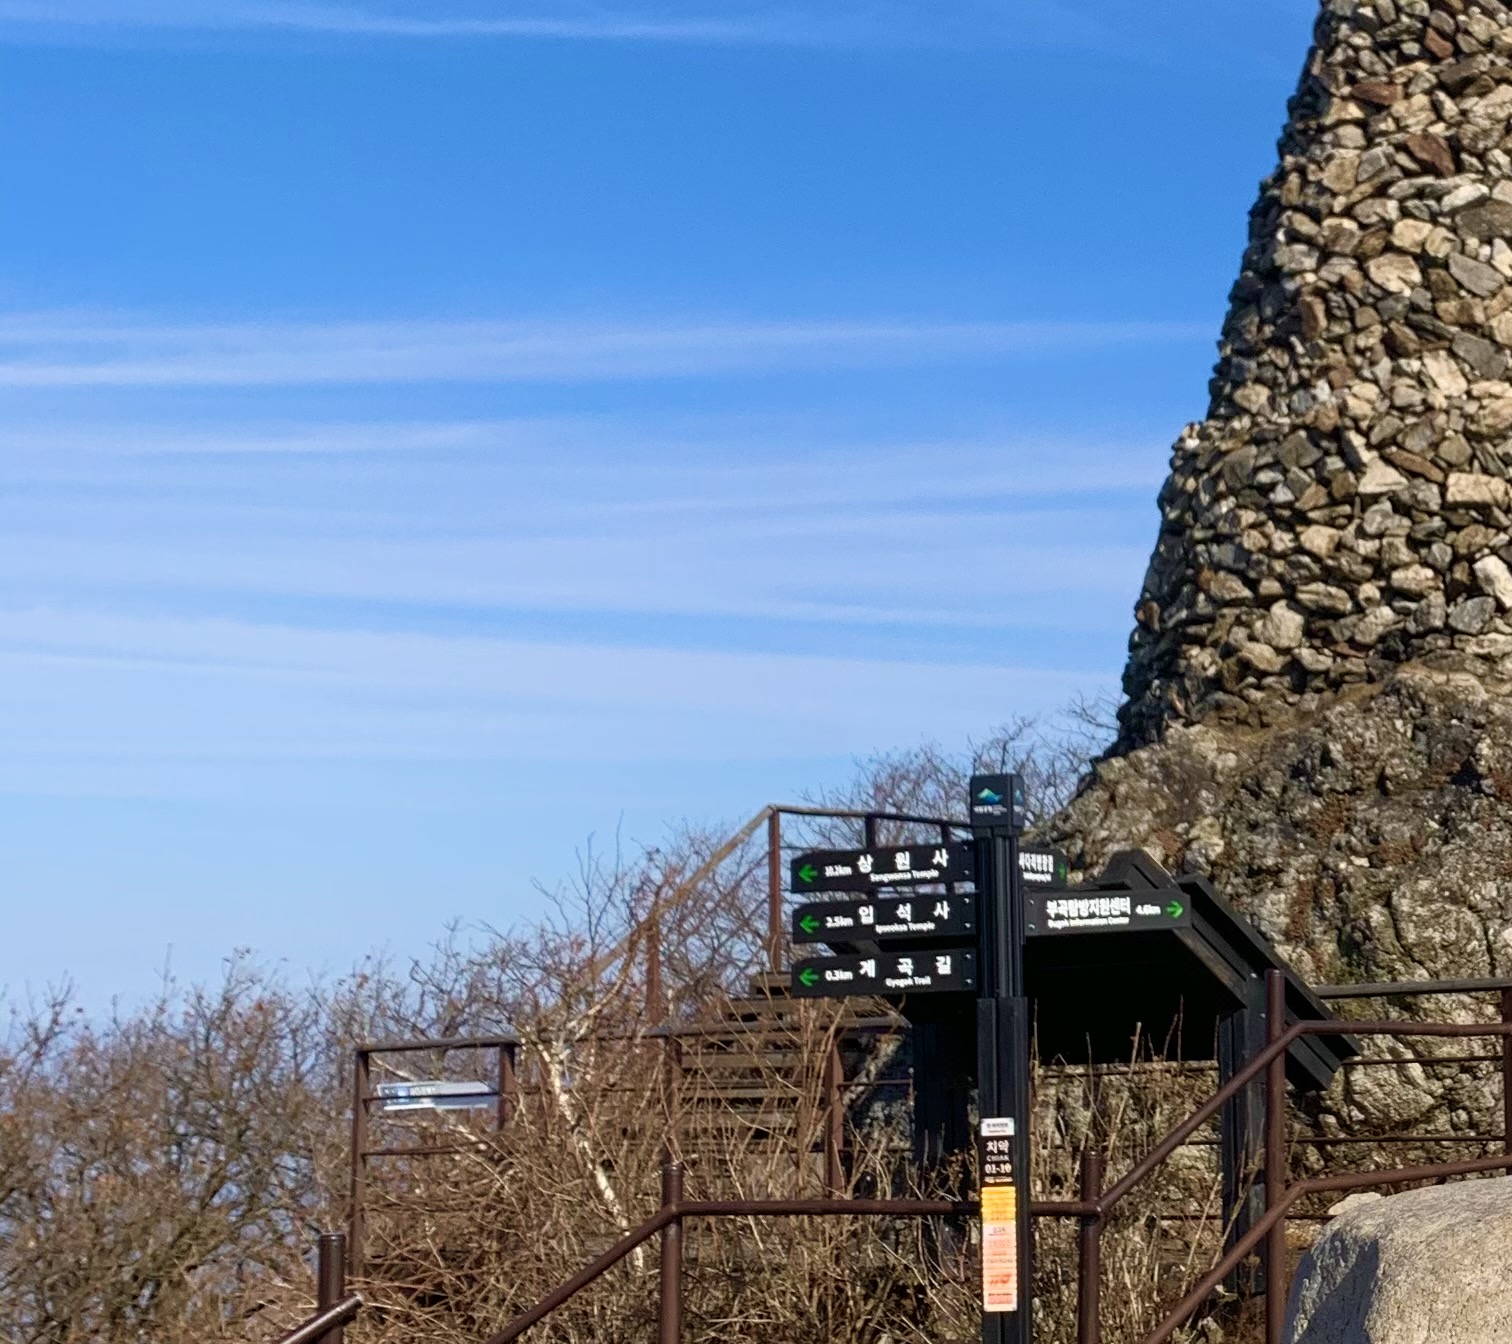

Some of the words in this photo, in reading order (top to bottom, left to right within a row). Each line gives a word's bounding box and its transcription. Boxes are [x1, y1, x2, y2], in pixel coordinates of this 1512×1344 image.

[857, 848, 949, 874] 상원사
[912, 868, 939, 880] Temple
[859, 900, 950, 925] 입석사
[1046, 896, 1131, 919] 부곡탐방지원센터
[908, 920, 936, 932] Temple
[825, 969, 853, 982] 0.3km
[859, 956, 952, 979] 계곡길
[914, 975, 932, 986] Trail
[986, 1139, 1010, 1154] 치악
